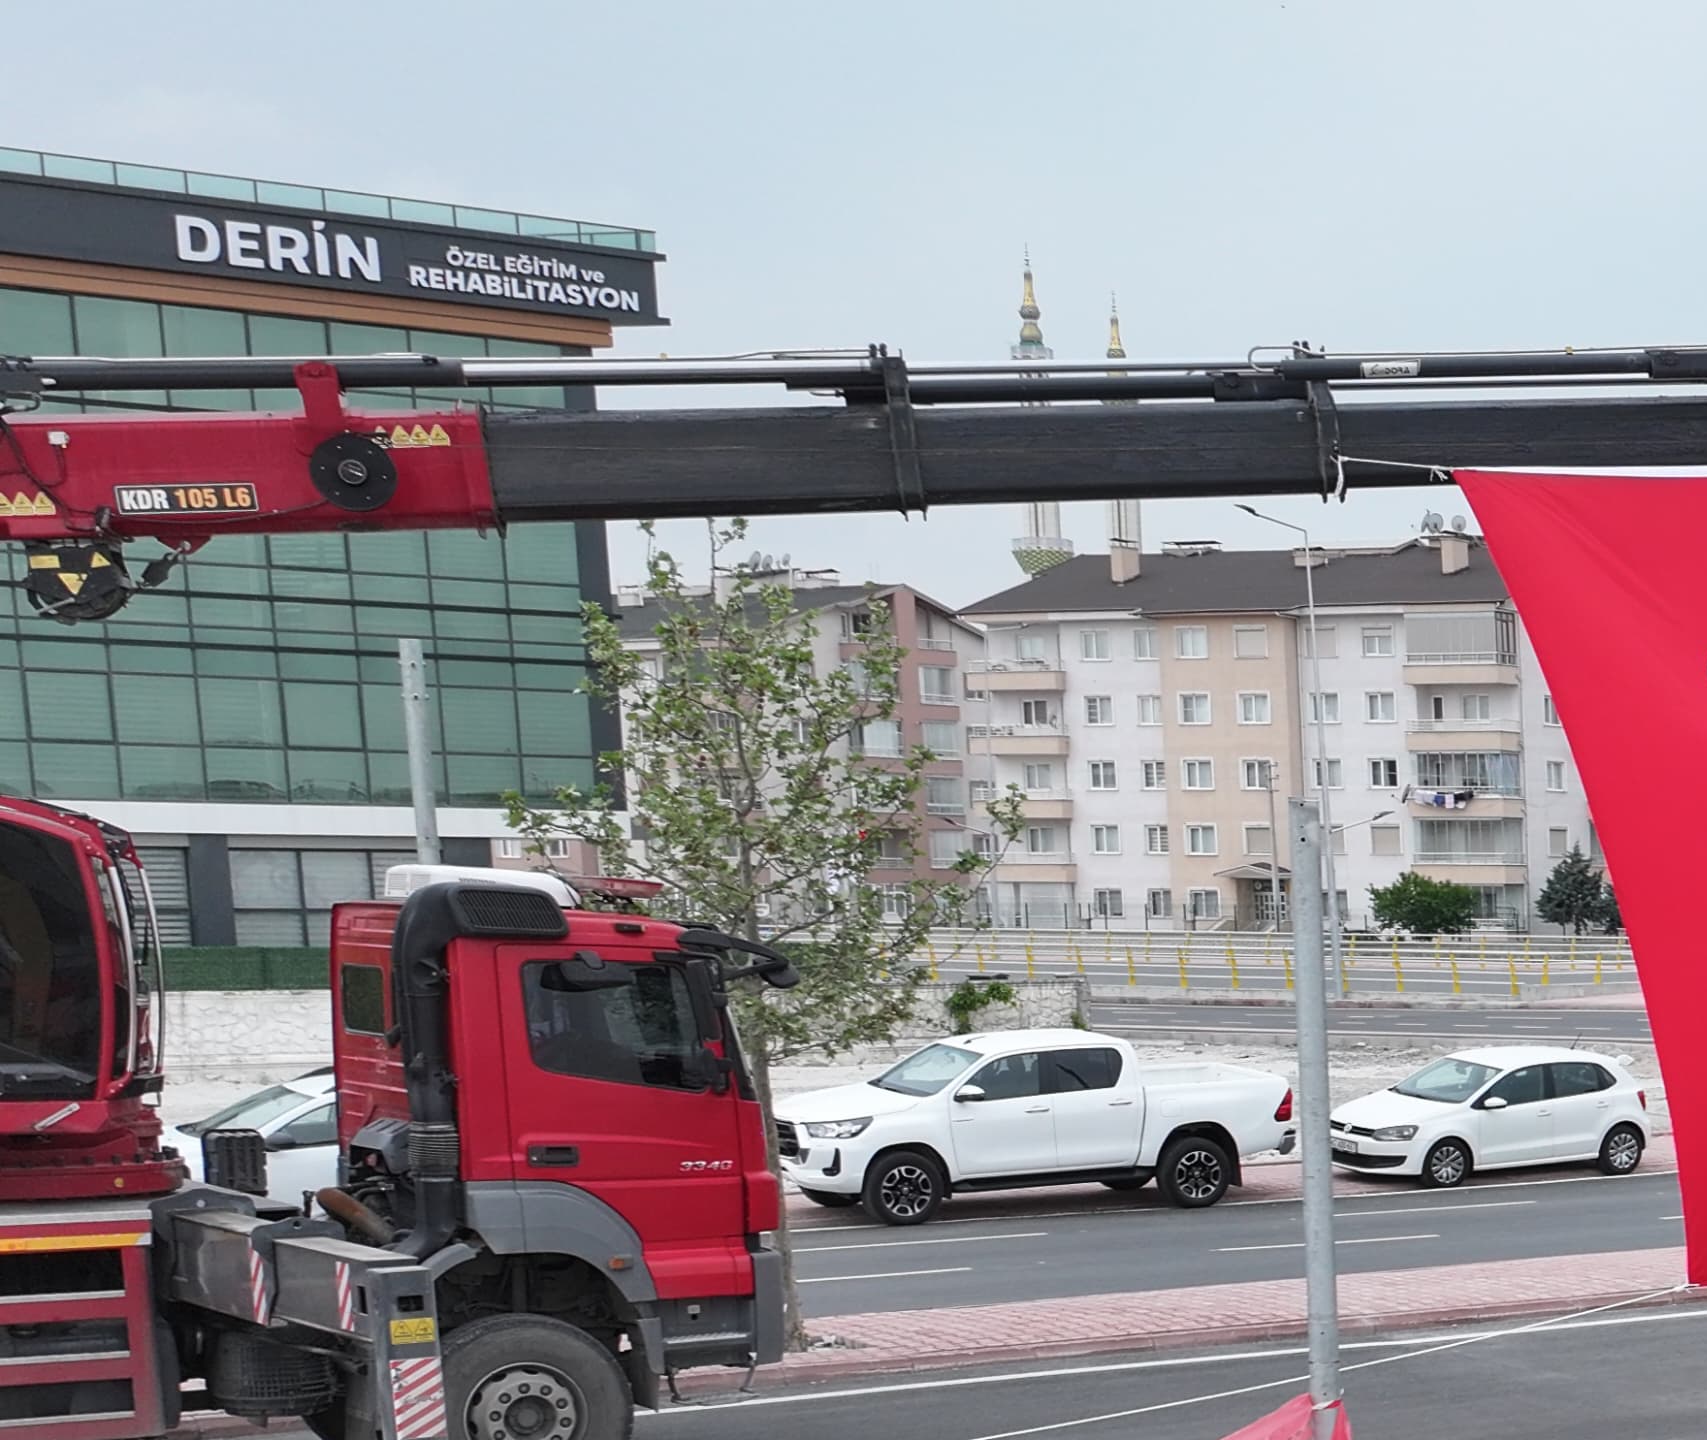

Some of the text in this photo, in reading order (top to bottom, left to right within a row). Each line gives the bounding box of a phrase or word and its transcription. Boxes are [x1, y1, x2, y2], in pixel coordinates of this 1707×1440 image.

[173, 213, 382, 284] DERİN
[445, 246, 605, 284] ÖZEL EĞİTİM ve
[120, 486, 251, 510] KDR 105 L6
